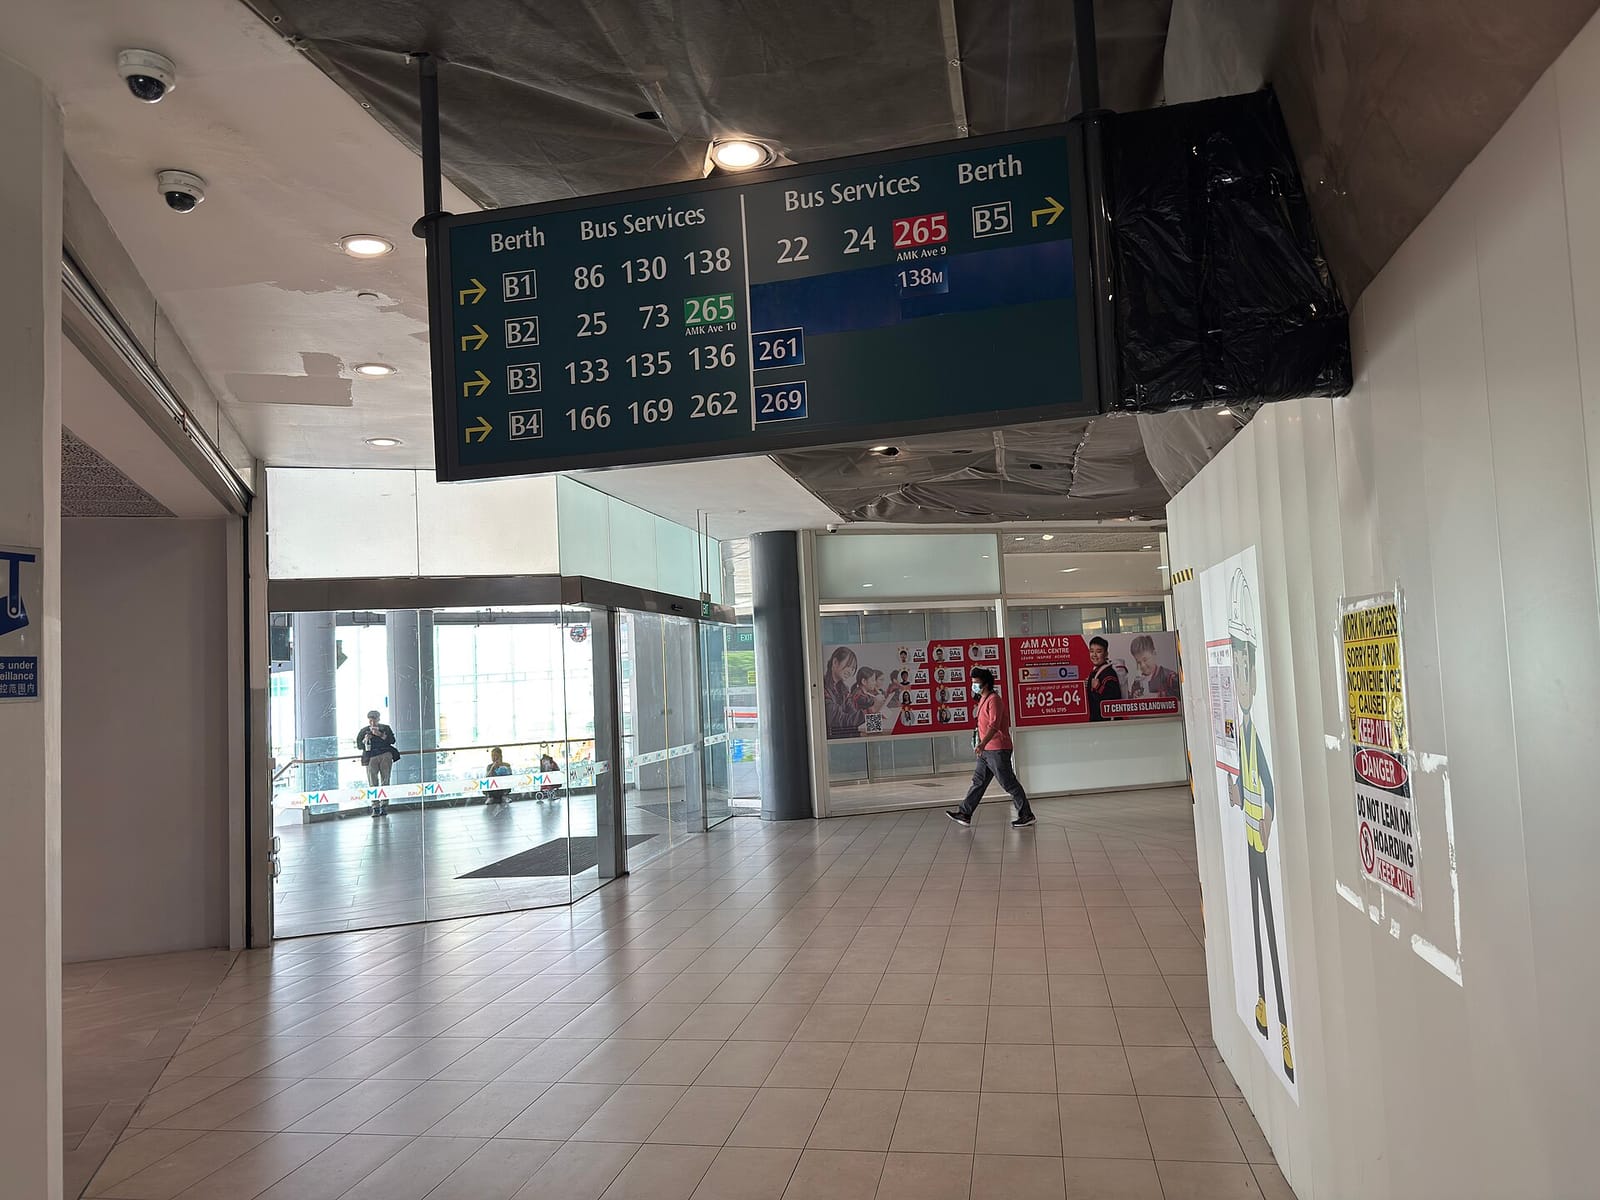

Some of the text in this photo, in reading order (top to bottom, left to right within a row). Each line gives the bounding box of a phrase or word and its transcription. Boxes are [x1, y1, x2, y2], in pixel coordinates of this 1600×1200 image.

[958, 154, 1022, 184] Berth
[785, 174, 920, 212] Bus Services
[580, 206, 706, 241] Bus Services
[777, 206, 1009, 264] 22 24 265 B5
[490, 226, 545, 252] Berth
[896, 246, 947, 262] AMK Ave 9
[505, 246, 732, 298] B1 86 130 138
[507, 296, 734, 344] B2 25 73 265
[684, 322, 737, 336] AMK Ave 10
[758, 338, 798, 362] 261
[509, 343, 736, 390] B3 133 135 136
[510, 390, 738, 436] B4 166 169 262
[760, 390, 802, 414] 269
[1343, 612, 1359, 640] WORK
[1365, 604, 1398, 638] PROGRESS
[1030, 638, 1070, 648] MAVIS
[1346, 644, 1396, 668] SORRY FOR ANY
[8, 661, 34, 670] under
[1347, 670, 1401, 692] NCONVENIENCE
[1026, 690, 1081, 708] #03-04
[1111, 703, 1138, 712] CENTRES
[1139, 701, 1176, 711] ISLANDWIDE
[1358, 694, 1387, 716] CAUSED
[1359, 718, 1374, 744] KEEP
[1361, 753, 1396, 784] DANGER
[1357, 793, 1412, 838] DO NOT LEAN ON
[1373, 828, 1414, 868] HOARDING
[1377, 858, 1395, 886] KEEP
